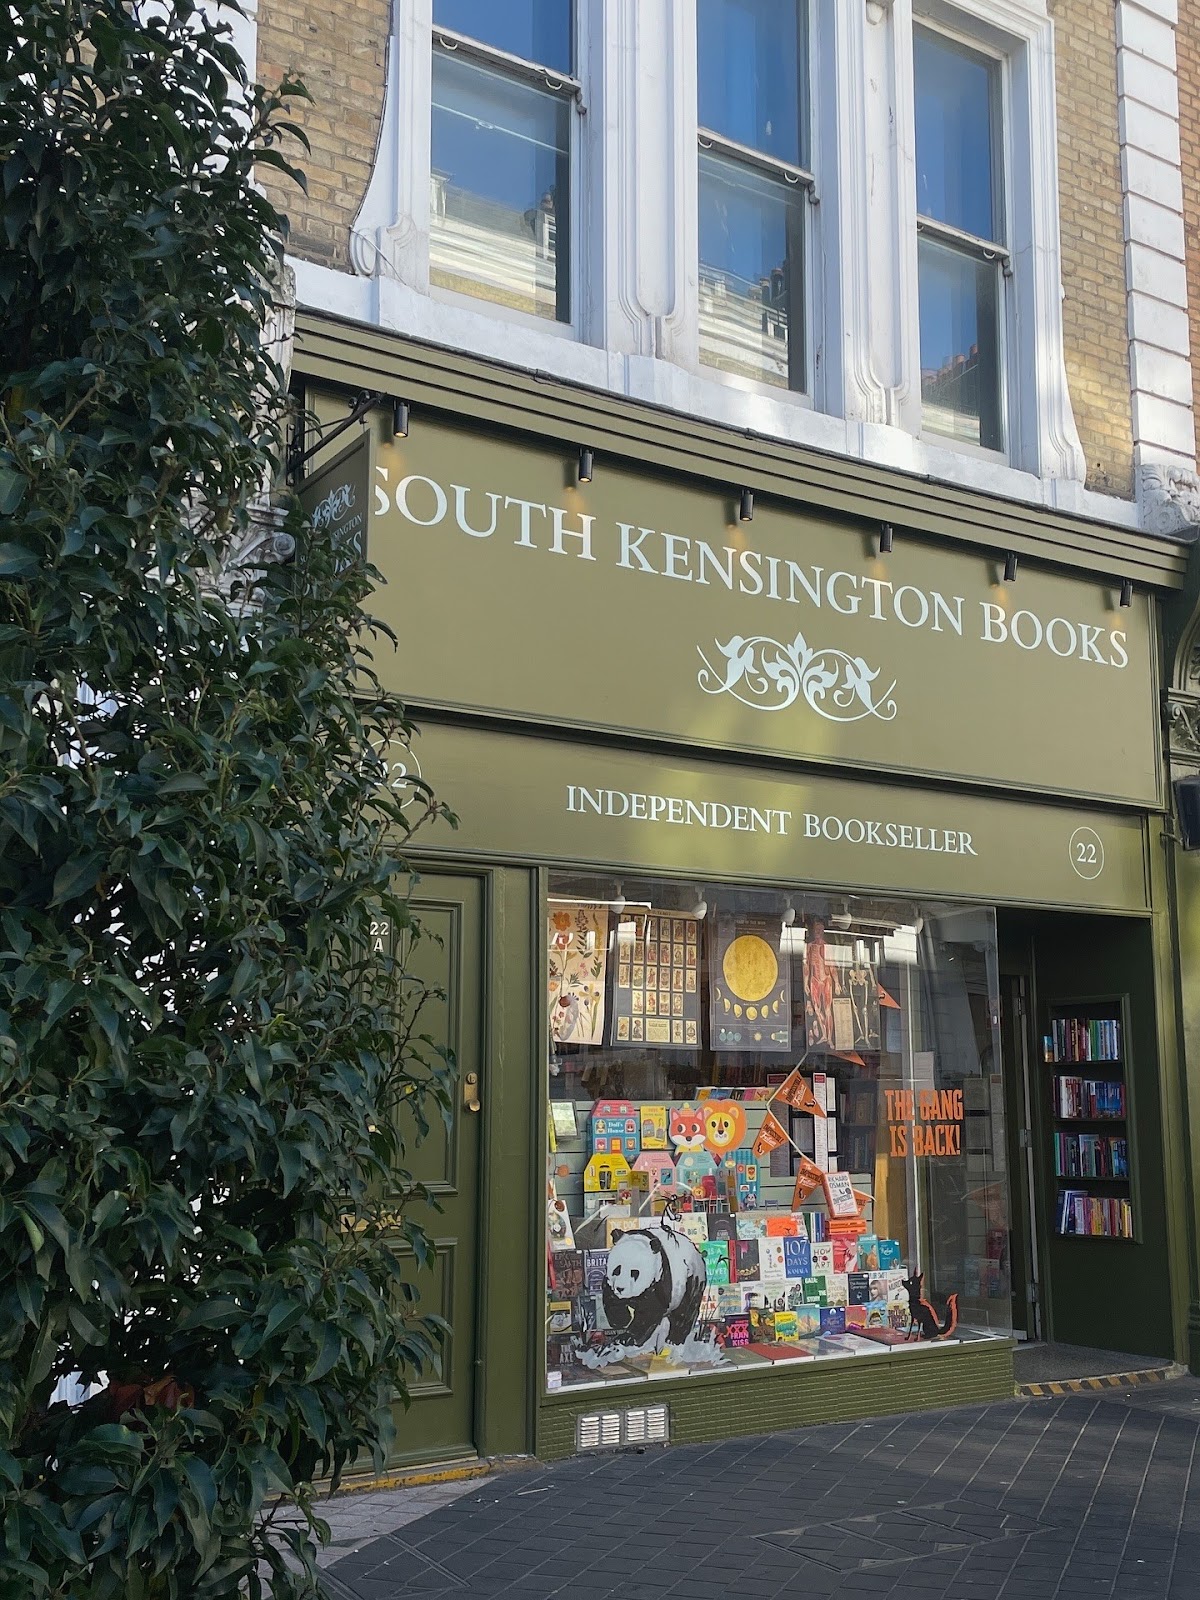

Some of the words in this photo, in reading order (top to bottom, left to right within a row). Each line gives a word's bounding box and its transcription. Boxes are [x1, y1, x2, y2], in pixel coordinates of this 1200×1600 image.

[374, 465, 597, 562] SOUTH
[615, 522, 965, 637] KENSINGTON
[979, 601, 1130, 670] BOOKS
[566, 785, 792, 836] INDEPENDENT
[803, 812, 978, 856] BOOKSELLER
[1075, 841, 1097, 864] 22
[369, 921, 389, 936] 22
[373, 938, 384, 952] A
[885, 1090, 915, 1121] THE
[919, 1089, 964, 1121] GANG
[889, 1125, 907, 1157] IS
[913, 1125, 961, 1157] BACK!
[785, 1240, 807, 1256] 107
[814, 1248, 831, 1256] HOW
[586, 1258, 607, 1267] BRITA
[786, 1257, 808, 1266] DAYS
[559, 1353, 574, 1363] AXE
